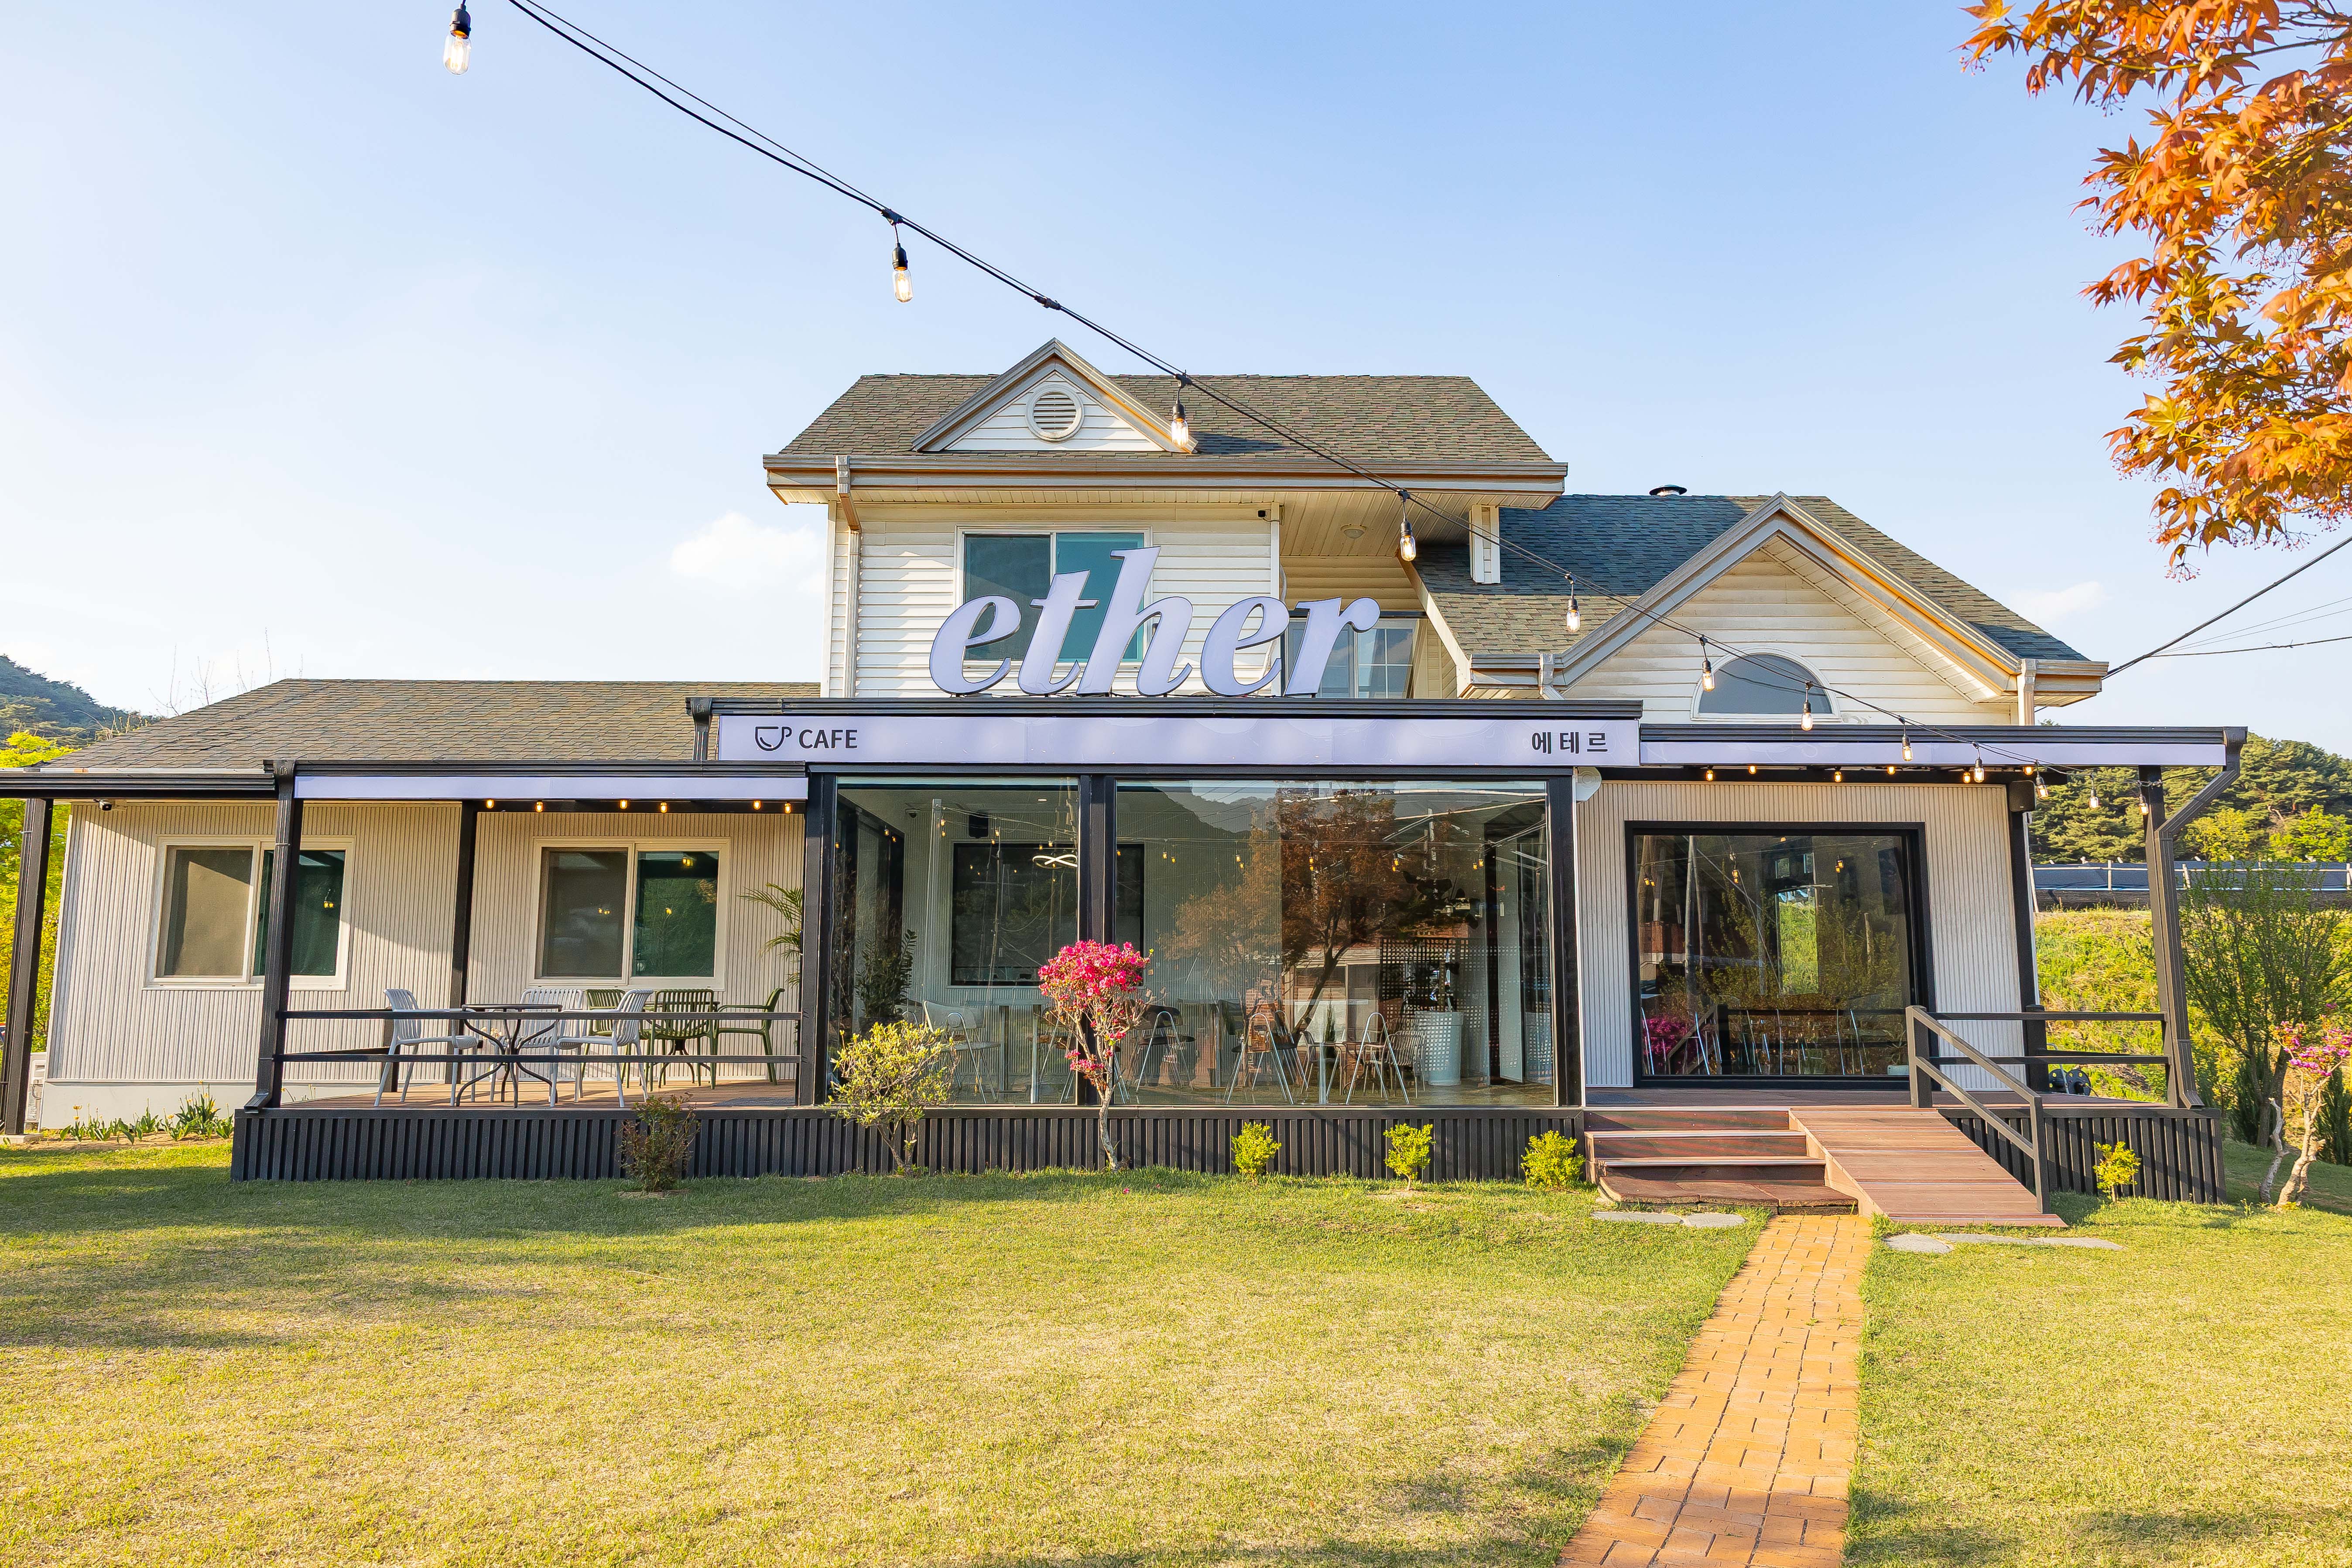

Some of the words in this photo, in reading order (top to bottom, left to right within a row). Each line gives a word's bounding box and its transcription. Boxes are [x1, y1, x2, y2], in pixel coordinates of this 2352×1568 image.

[929, 546, 1380, 696] ether
[798, 729, 858, 749] CAFE
[1532, 731, 1608, 754] 에테르
